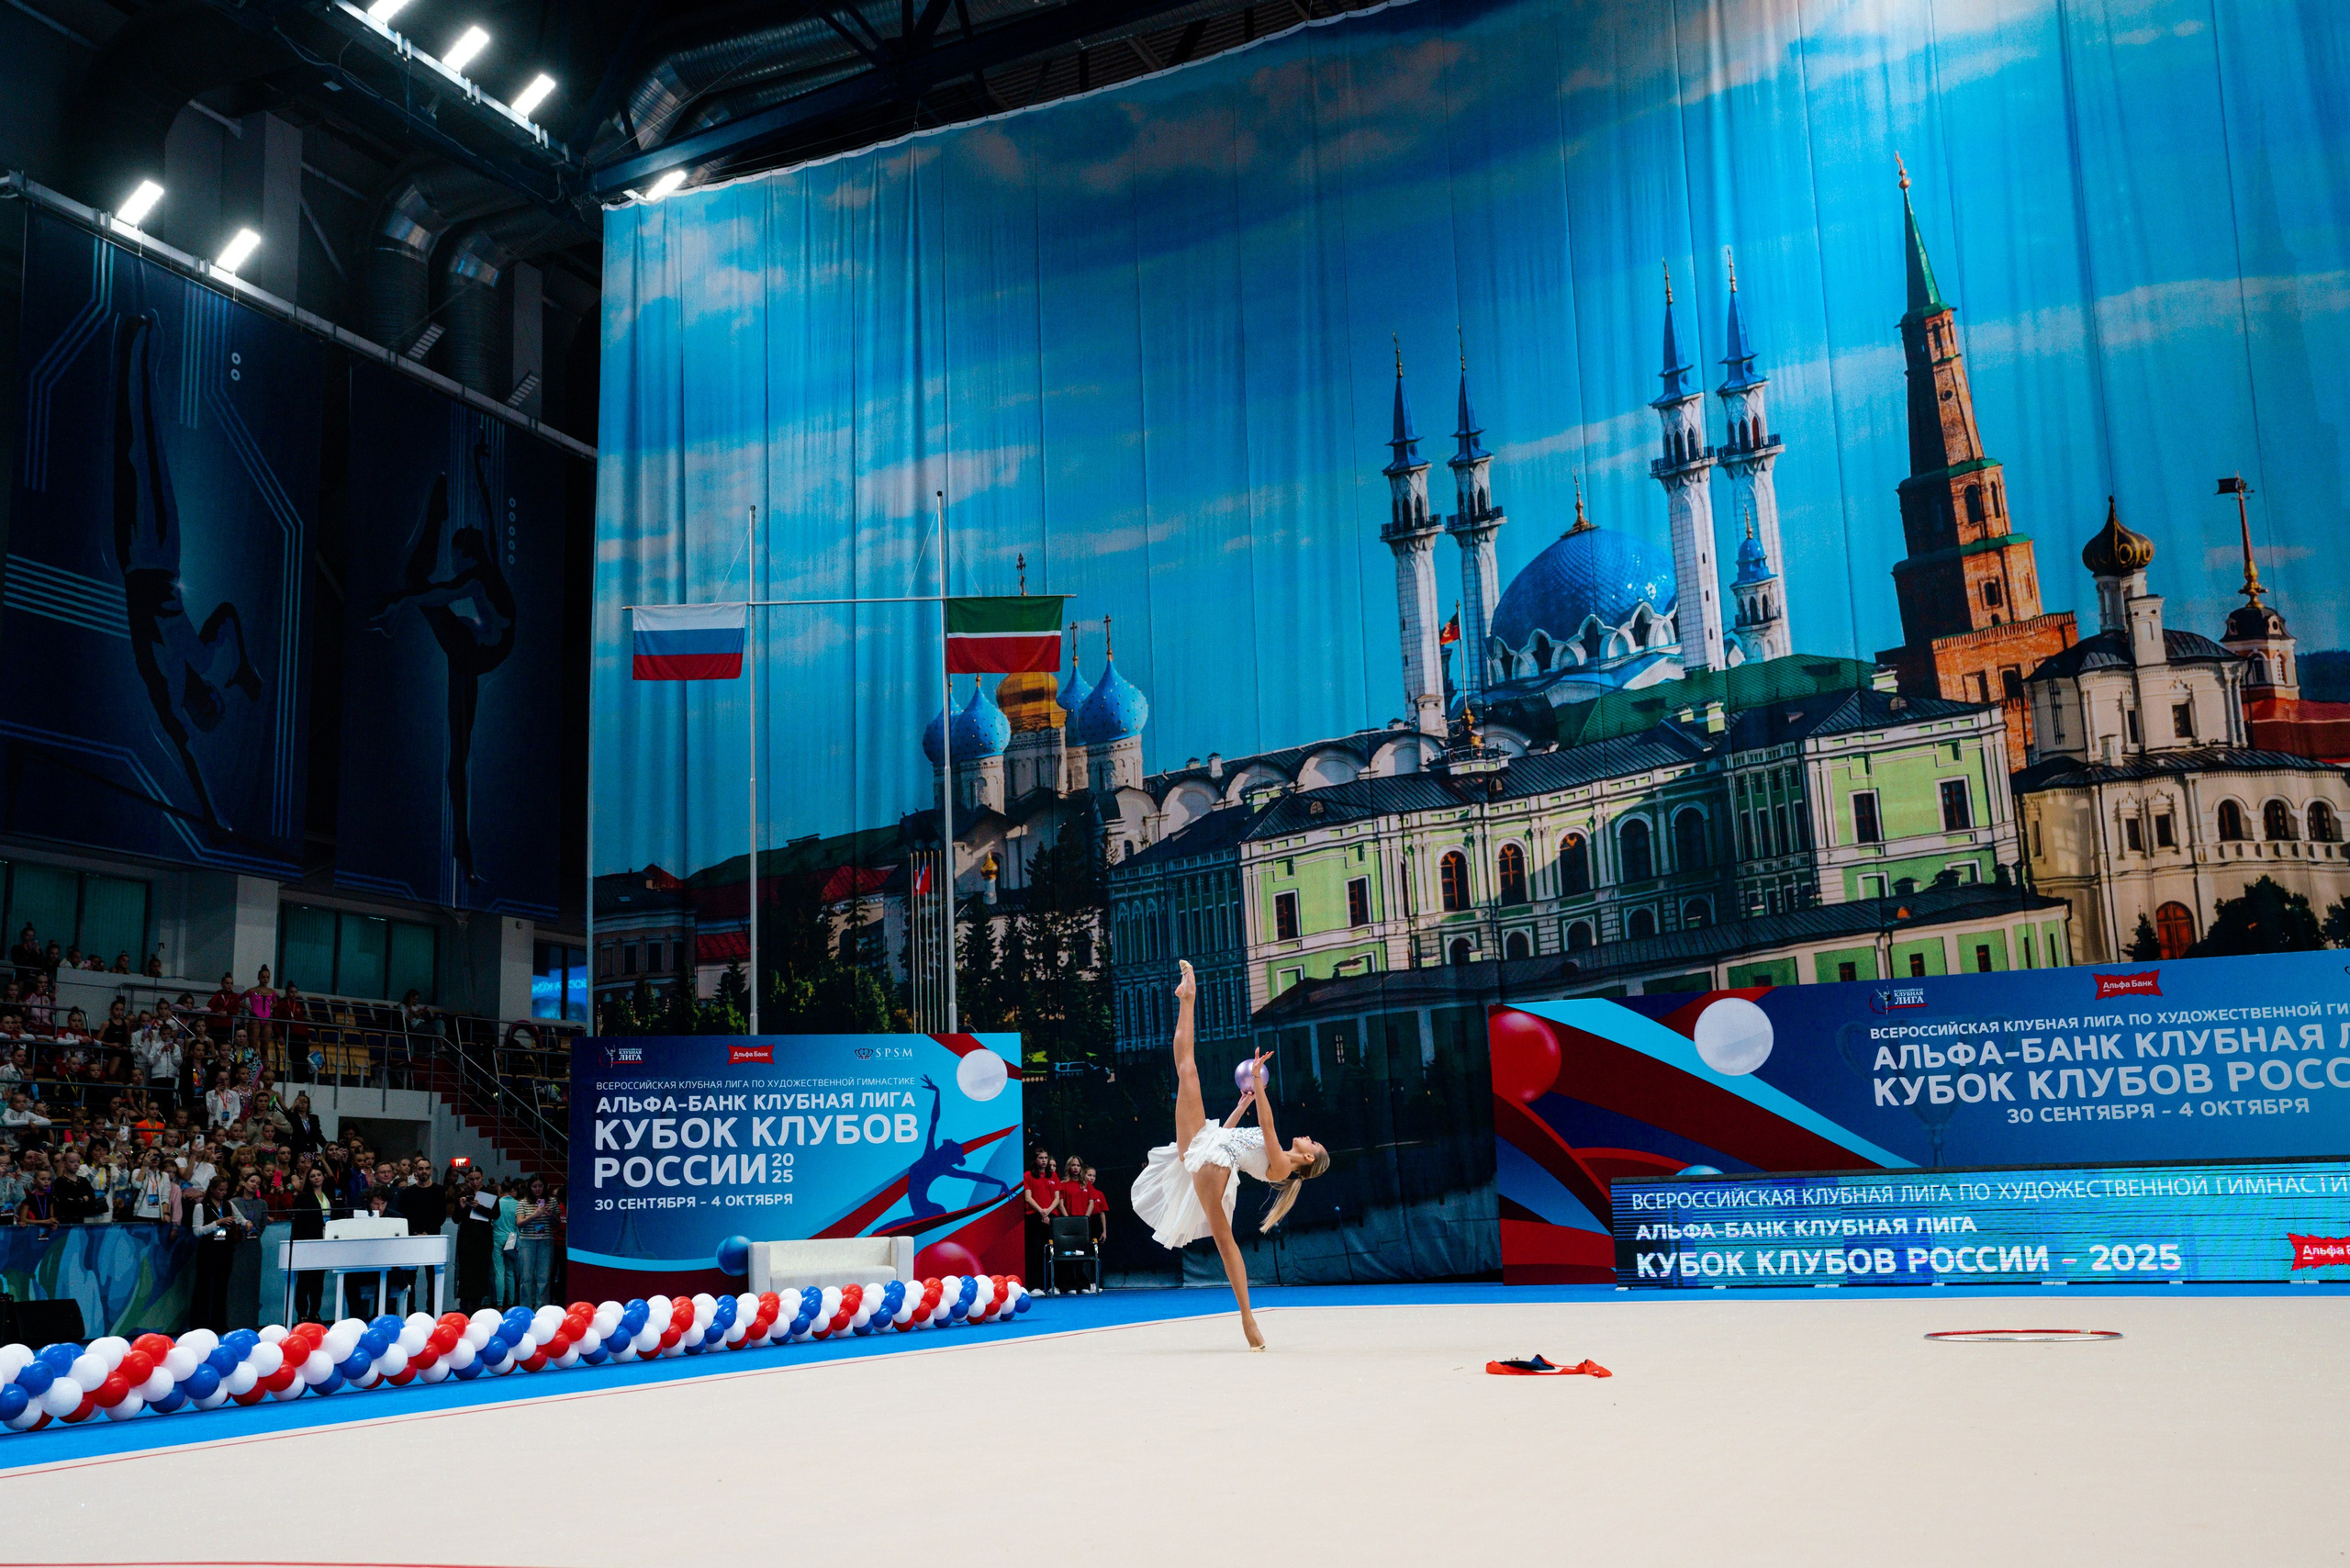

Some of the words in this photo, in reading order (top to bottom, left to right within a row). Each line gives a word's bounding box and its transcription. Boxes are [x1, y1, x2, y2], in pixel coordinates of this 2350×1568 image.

[2103, 980, 2130, 991] Альфа
[1895, 996, 1925, 1004] ЛИГА
[1871, 1022, 1999, 1039] ВСЕРОССИЙСКАЯ
[2004, 1017, 2078, 1032] КЛУБНАЯ
[2084, 1015, 2124, 1027] ЛИГА
[2130, 1014, 2152, 1025] ПО
[2157, 1002, 2321, 1024] ХУДОЖЕСТВЕННОЙ
[2327, 1003, 2350, 1014] ГИ
[1874, 1034, 2124, 1070] АЛЬФА-БАНК
[2135, 1025, 2324, 1058] КЛУБНАЯ
[597, 1080, 676, 1090] ВСЕРОССИЙСКАЯ
[679, 1081, 722, 1089] КЛУБНАЯ
[767, 1077, 854, 1088] ХУДОЖЕСТВЕННОЙ
[1874, 1072, 2016, 1106] КУБОК
[2029, 1064, 2212, 1100] КЛУБОВ
[2227, 1058, 2350, 1092] РОСС
[597, 1095, 746, 1113] АЛЬФА-БАНК
[755, 1092, 853, 1110] КЛУБНАЯ
[860, 1092, 915, 1107] ЛИГА
[2007, 1108, 2033, 1124] 30
[2041, 1103, 2154, 1122] СЕНТЯБРЯ
[2179, 1103, 2193, 1116] 4
[2201, 1098, 2310, 1116] ОКТЯБРЯ
[596, 1117, 737, 1150] КУБОК
[753, 1114, 918, 1146] КЛУБОВ
[595, 1154, 767, 1188] РОССИИ
[772, 1153, 793, 1167] 20
[772, 1170, 793, 1183] 25
[595, 1199, 613, 1210] 30
[619, 1197, 695, 1209] СЕНТЯБРЯ
[711, 1196, 721, 1206] 4
[725, 1193, 792, 1206] ОКТЯБРЯ
[1633, 1188, 1796, 1210] ВСЕРОССИЙСКАЯ
[1803, 1186, 1893, 1204] КЛУБНАЯ
[1901, 1184, 1953, 1202] ЛИГА
[1960, 1183, 1990, 1200] ПО
[1998, 1175, 2208, 1203] ХУДОЖЕСТВЕННОЙ
[2216, 1174, 2350, 1194] ГИМНАСТИ
[1637, 1221, 1787, 1239] АЛЬФА-БАНК
[1795, 1218, 1908, 1236] КЛУБНАЯ
[1917, 1216, 1977, 1233] ЛИГА
[1637, 1251, 1746, 1277] КУБОК
[1757, 1249, 1897, 1275] КЛУБОВ
[1908, 1245, 2049, 1272] РОССИИ
[2089, 1244, 2181, 1271] 2025
[2302, 1245, 2344, 1259] Альфа
